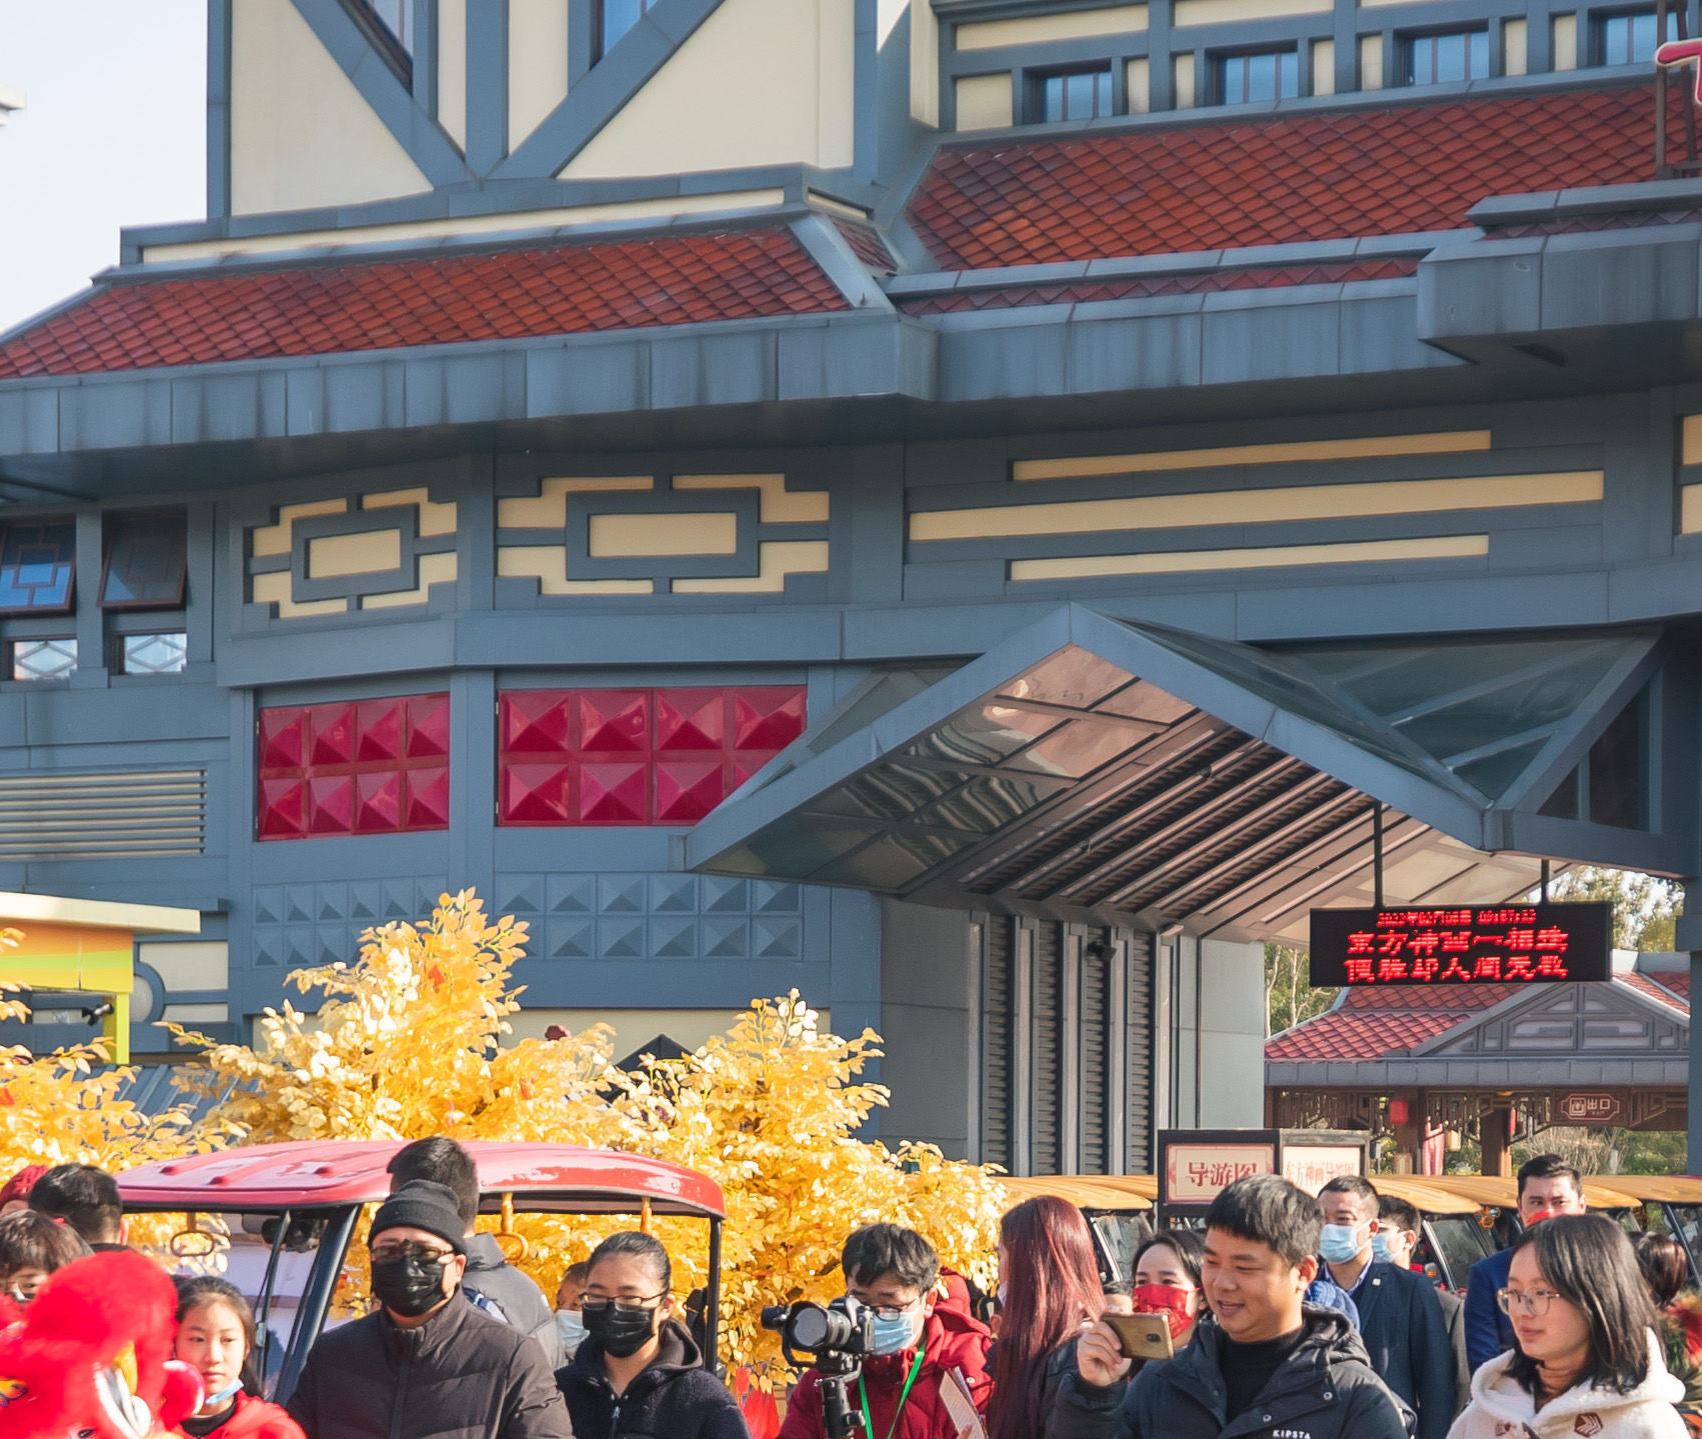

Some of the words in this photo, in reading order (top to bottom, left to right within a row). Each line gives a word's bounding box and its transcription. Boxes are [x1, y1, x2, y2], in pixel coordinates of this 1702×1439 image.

[1187, 1161, 1258, 1188] 导游图
[1273, 1429, 1311, 1439] KIPSTA
